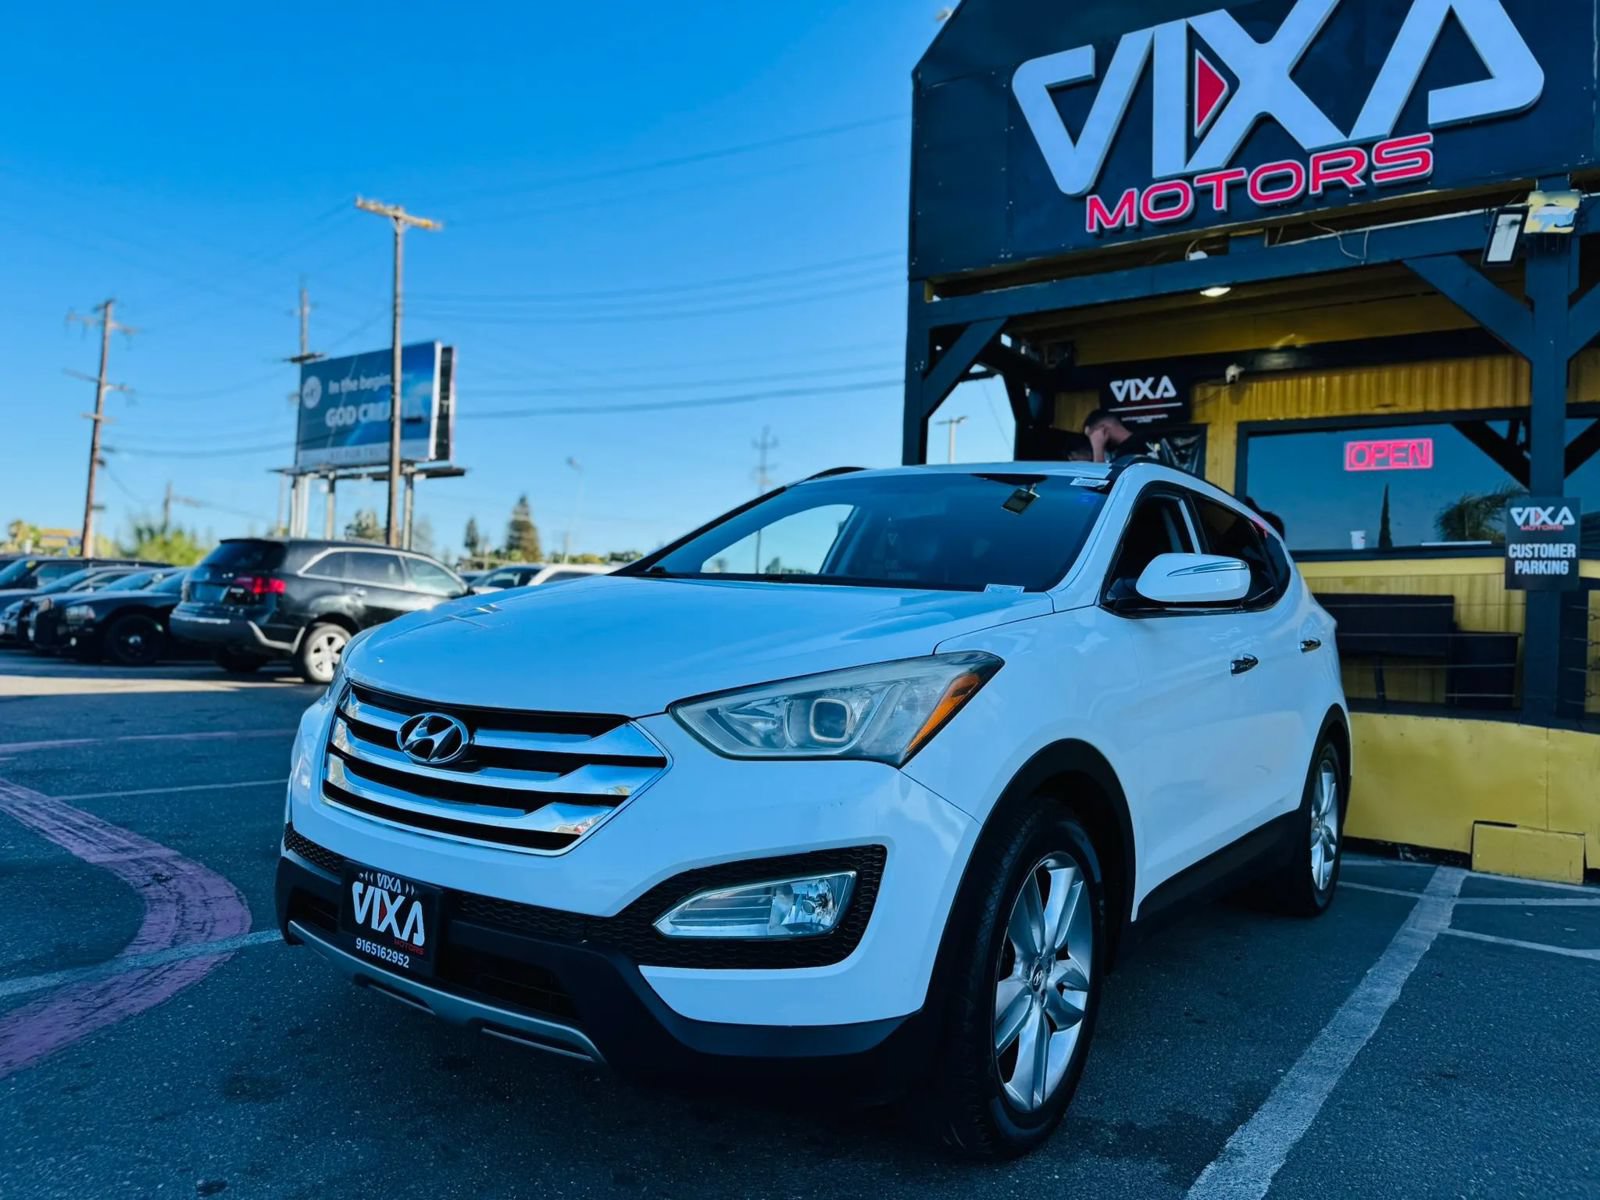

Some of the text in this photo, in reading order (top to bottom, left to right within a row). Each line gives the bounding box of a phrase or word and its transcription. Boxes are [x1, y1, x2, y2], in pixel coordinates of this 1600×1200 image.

[1011, 0, 1545, 196] VIXA
[1086, 133, 1435, 233] MOTORS
[1109, 375, 1177, 402] VIXA
[325, 405, 357, 428] GOD
[1350, 441, 1429, 468] OPEN
[1510, 506, 1576, 526] VIXA
[1508, 543, 1577, 559] CUSTOMER
[1514, 560, 1570, 575] PARKING
[376, 872, 402, 894] VIXA
[352, 881, 425, 947] VIXA
[355, 937, 411, 969] 9165162952
